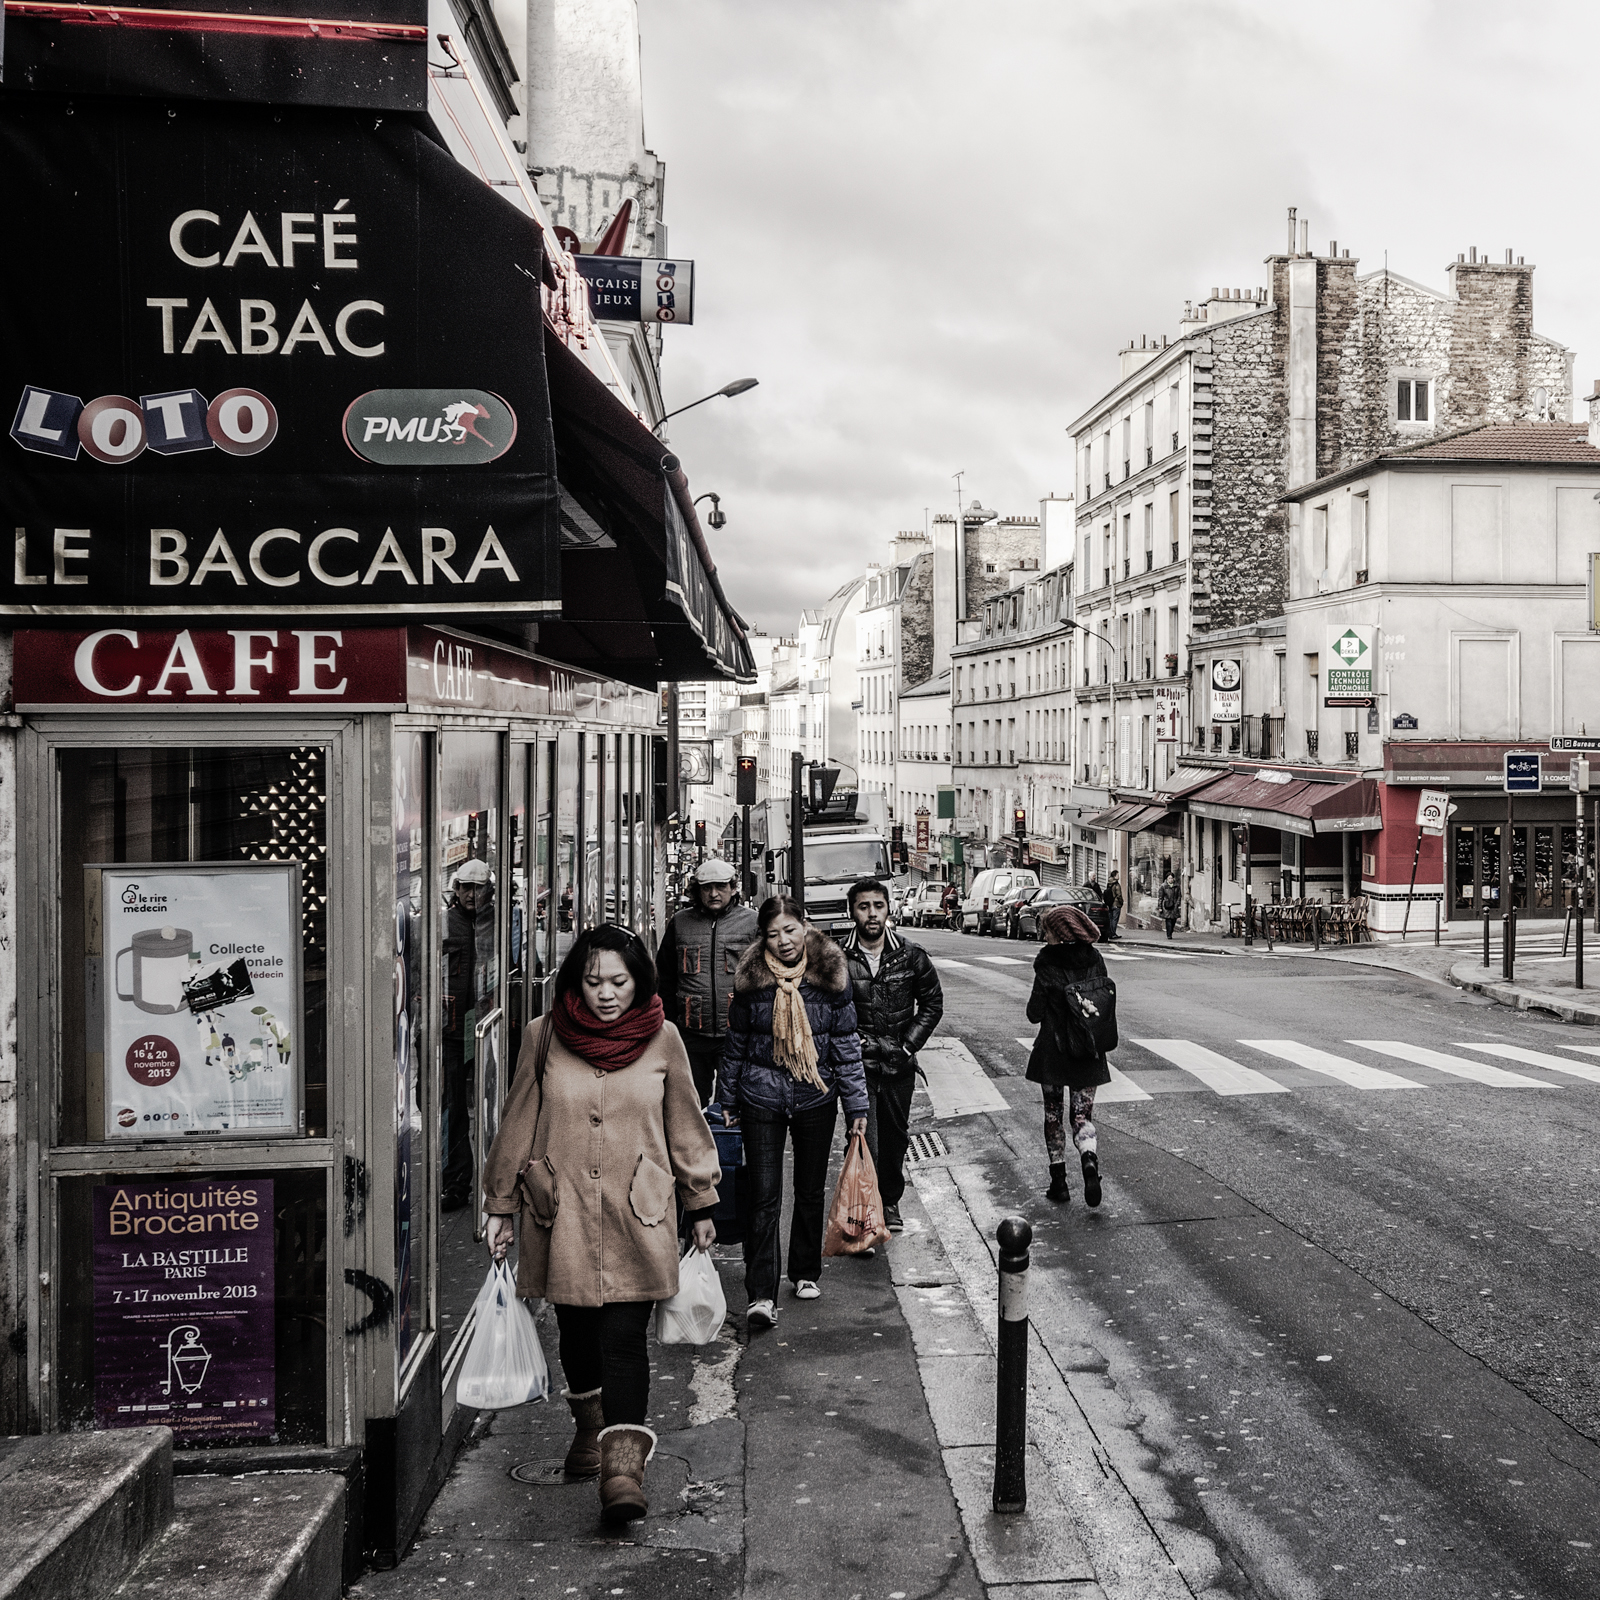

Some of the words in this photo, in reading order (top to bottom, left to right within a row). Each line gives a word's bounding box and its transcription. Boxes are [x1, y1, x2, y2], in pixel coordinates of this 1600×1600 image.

[169, 199, 359, 270] CAFÉ
[595, 294, 632, 305] JEUX
[146, 297, 386, 358] TABAC
[13, 387, 275, 462] LOTO
[363, 416, 442, 444] PMU
[13, 527, 91, 586] LE
[149, 527, 521, 586] BACCARA
[73, 629, 349, 699] CAFE
[433, 639, 474, 701] CAFE
[1330, 669, 1370, 678] CONTRÔLE
[1330, 677, 1370, 685] TECHNIQUE
[550, 669, 576, 712] TABAC
[1166, 687, 1180, 700] Photo
[1218, 692, 1240, 702] TRIANON
[1572, 740, 1596, 748] Bureau
[1426, 809, 1438, 818] 30
[138, 893, 148, 903] le
[149, 892, 168, 903] rire
[123, 902, 168, 913] médecin
[209, 943, 265, 955] Collecte
[246, 955, 284, 967] onale
[143, 1041, 155, 1050] 17
[133, 1049, 146, 1058] 16
[146, 1052, 154, 1060] &
[155, 1050, 168, 1059] 20
[133, 1060, 176, 1069] novembre
[147, 1068, 172, 1078] 2013
[109, 1184, 258, 1214] Antiquités
[109, 1209, 260, 1236] Brocante
[121, 1252, 149, 1268] LA
[151, 1247, 249, 1267] BASTILLE
[164, 1265, 207, 1280] PARIS
[112, 1290, 123, 1304] 7
[132, 1289, 150, 1303] 17
[152, 1284, 221, 1302] novembre
[222, 1285, 258, 1299] 2013
[181, 1415, 222, 1424] Organisation
